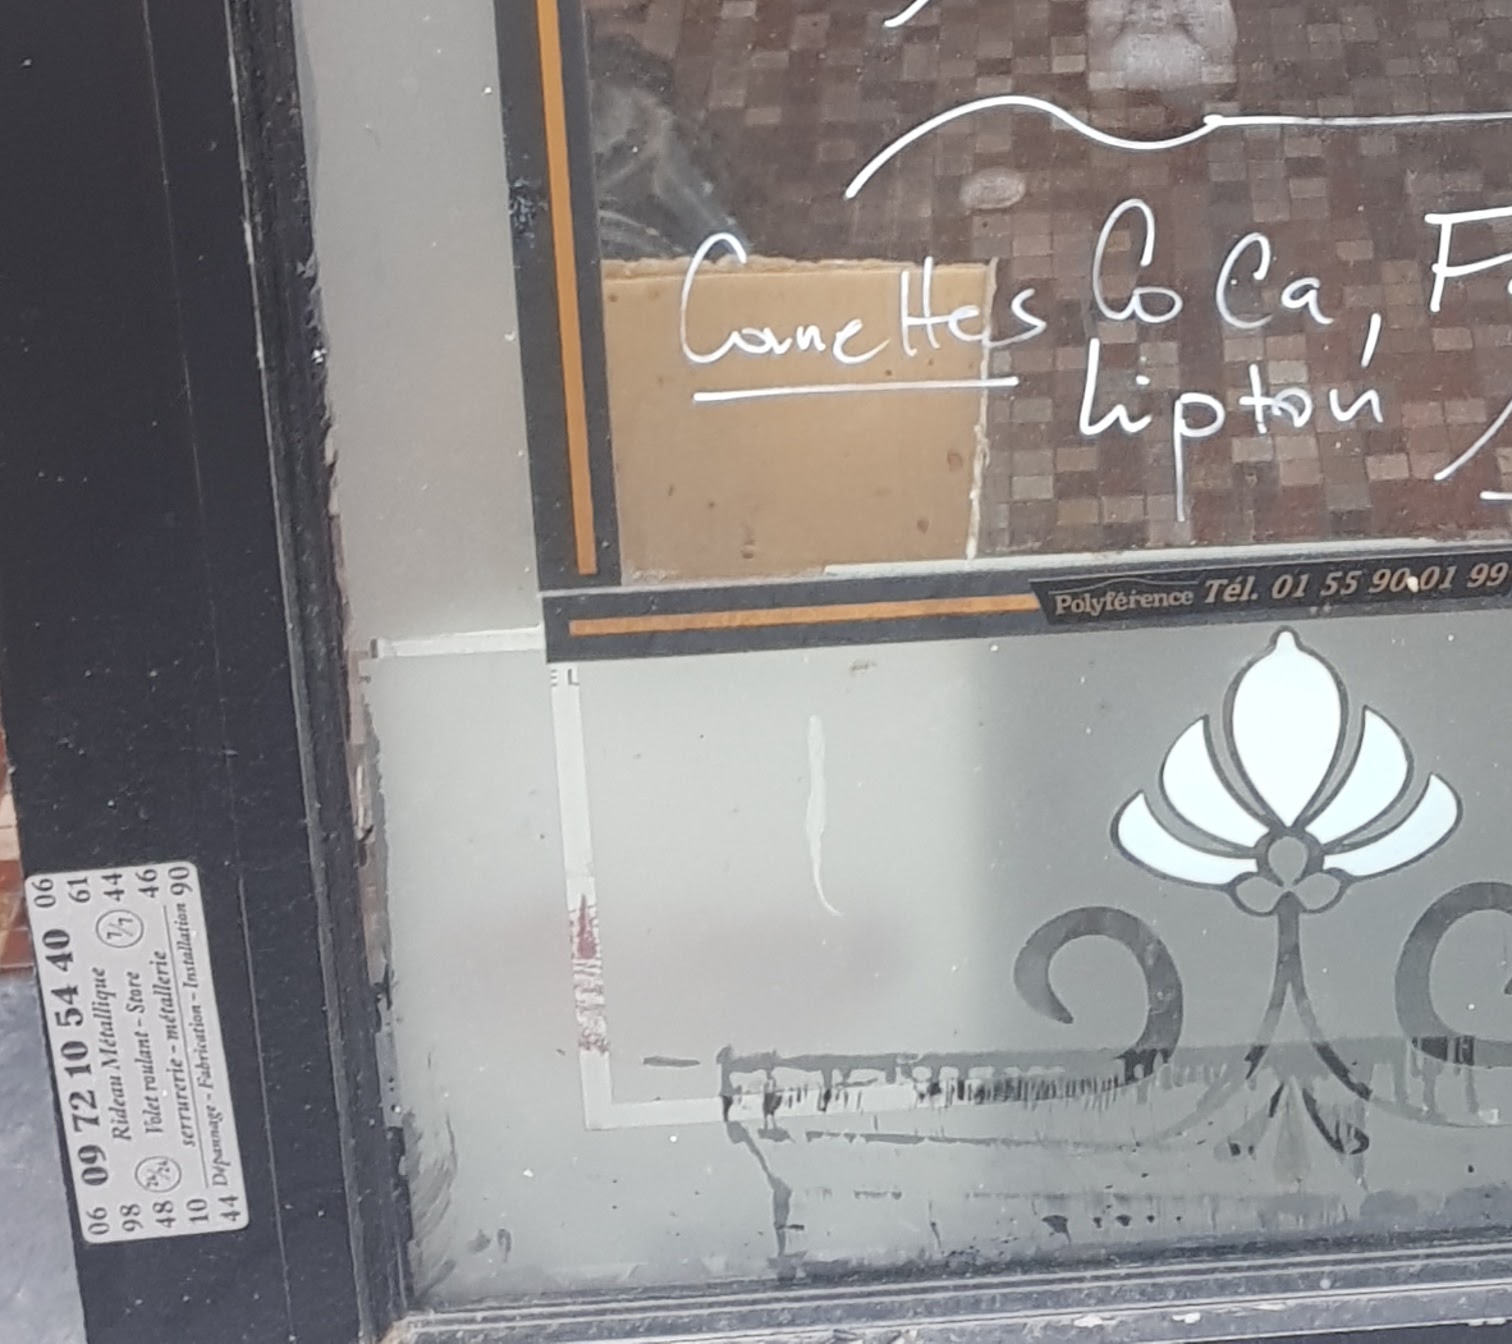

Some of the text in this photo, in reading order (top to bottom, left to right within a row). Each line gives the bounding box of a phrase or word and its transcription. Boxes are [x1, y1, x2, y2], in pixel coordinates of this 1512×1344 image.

[1054, 561, 1509, 618] Polyférence Tél. 01 55 90 01 99
[31, 877, 57, 909] 06
[66, 876, 92, 904] 61
[101, 873, 125, 902] 44
[135, 868, 160, 899] 46
[167, 866, 193, 896] 90
[174, 902, 199, 989] Installation
[125, 971, 146, 1014] Store
[149, 950, 179, 1041] métallerie
[42, 928, 110, 1187] 09 72 10 54 40
[91, 967, 133, 1142] Rideau Métallique
[133, 1030, 157, 1092] roulant
[189, 1005, 214, 1090] Fabrication
[141, 1095, 164, 1135] Volet
[166, 1057, 196, 1148] serrurerie
[206, 1104, 231, 1187] Dépannage
[86, 1205, 111, 1236] 06
[119, 1202, 145, 1233] 98
[152, 1199, 177, 1229] 48
[186, 1198, 210, 1225] 10
[218, 1194, 241, 1222] 44
